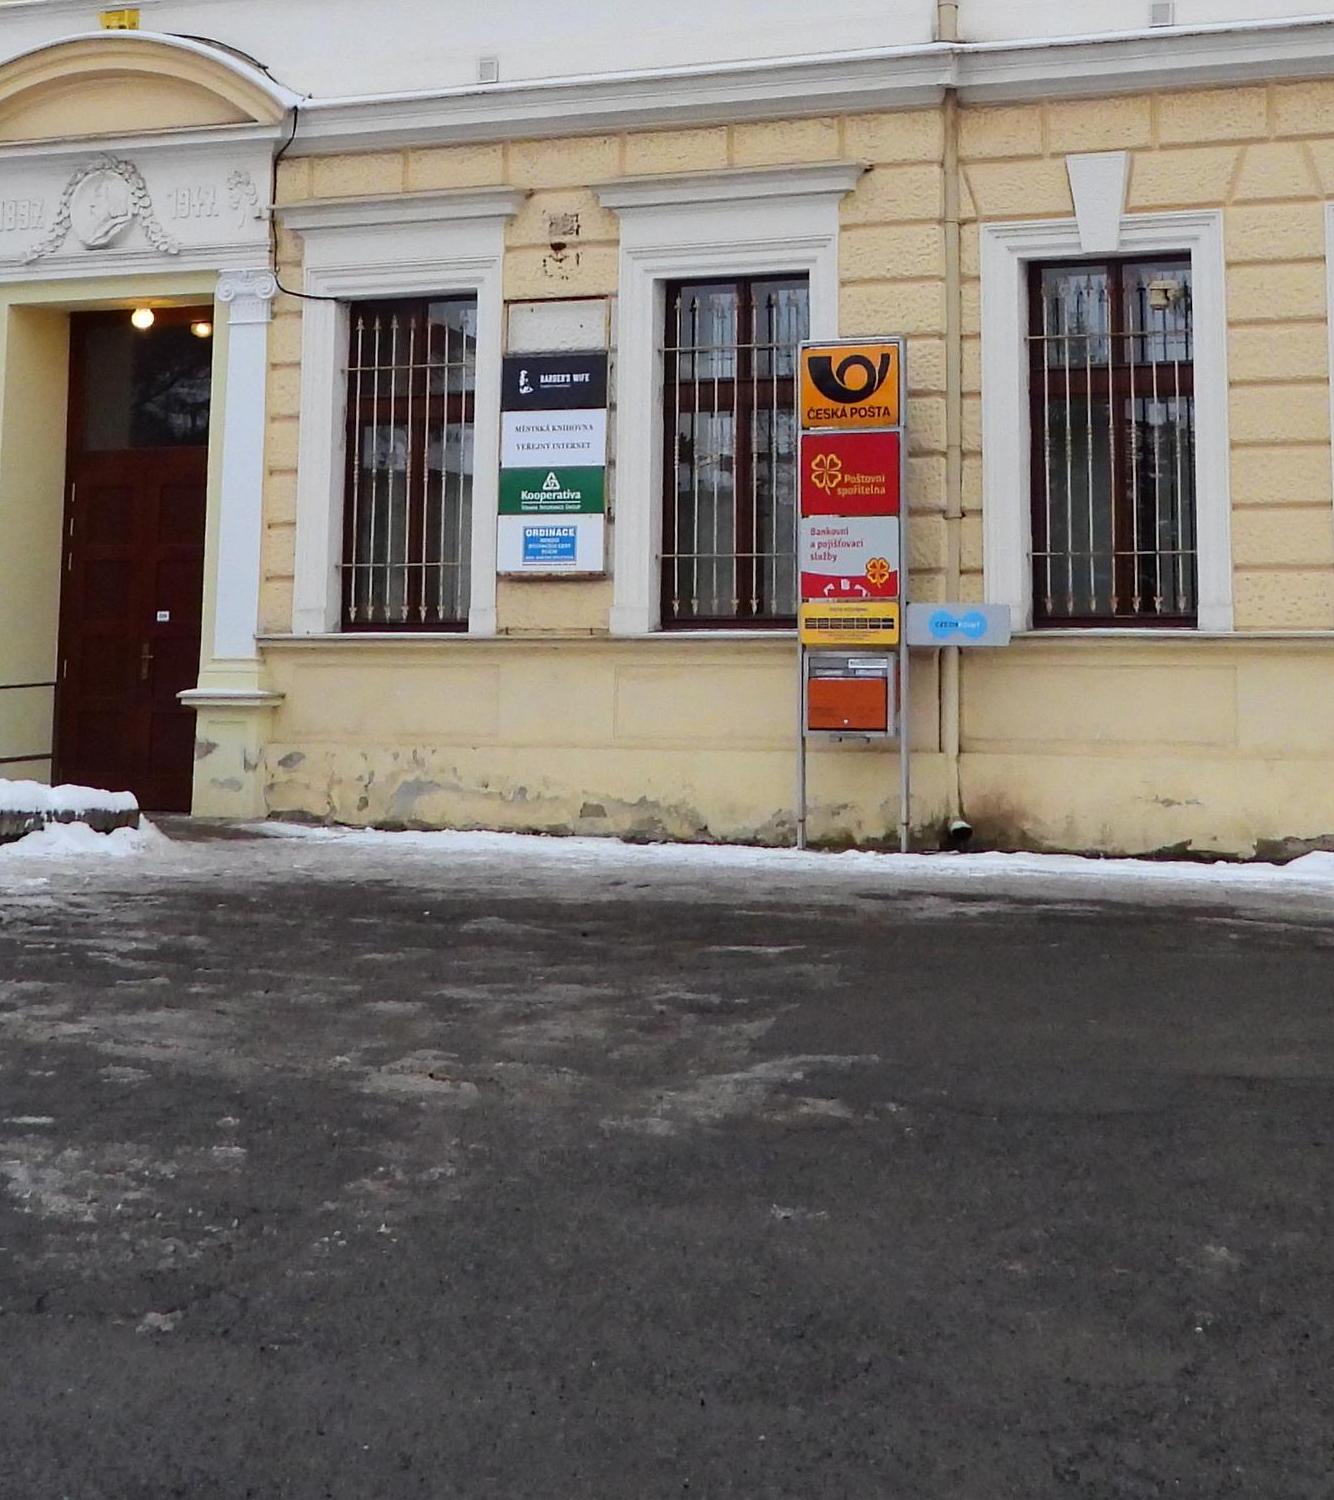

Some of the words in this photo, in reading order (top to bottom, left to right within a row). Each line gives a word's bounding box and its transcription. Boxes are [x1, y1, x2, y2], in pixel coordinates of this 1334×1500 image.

[807, 406, 847, 420] ČESKÁ
[850, 405, 891, 418] POŠTA
[521, 489, 581, 503] Kooperativa
[525, 528, 575, 537] ORDINACE
